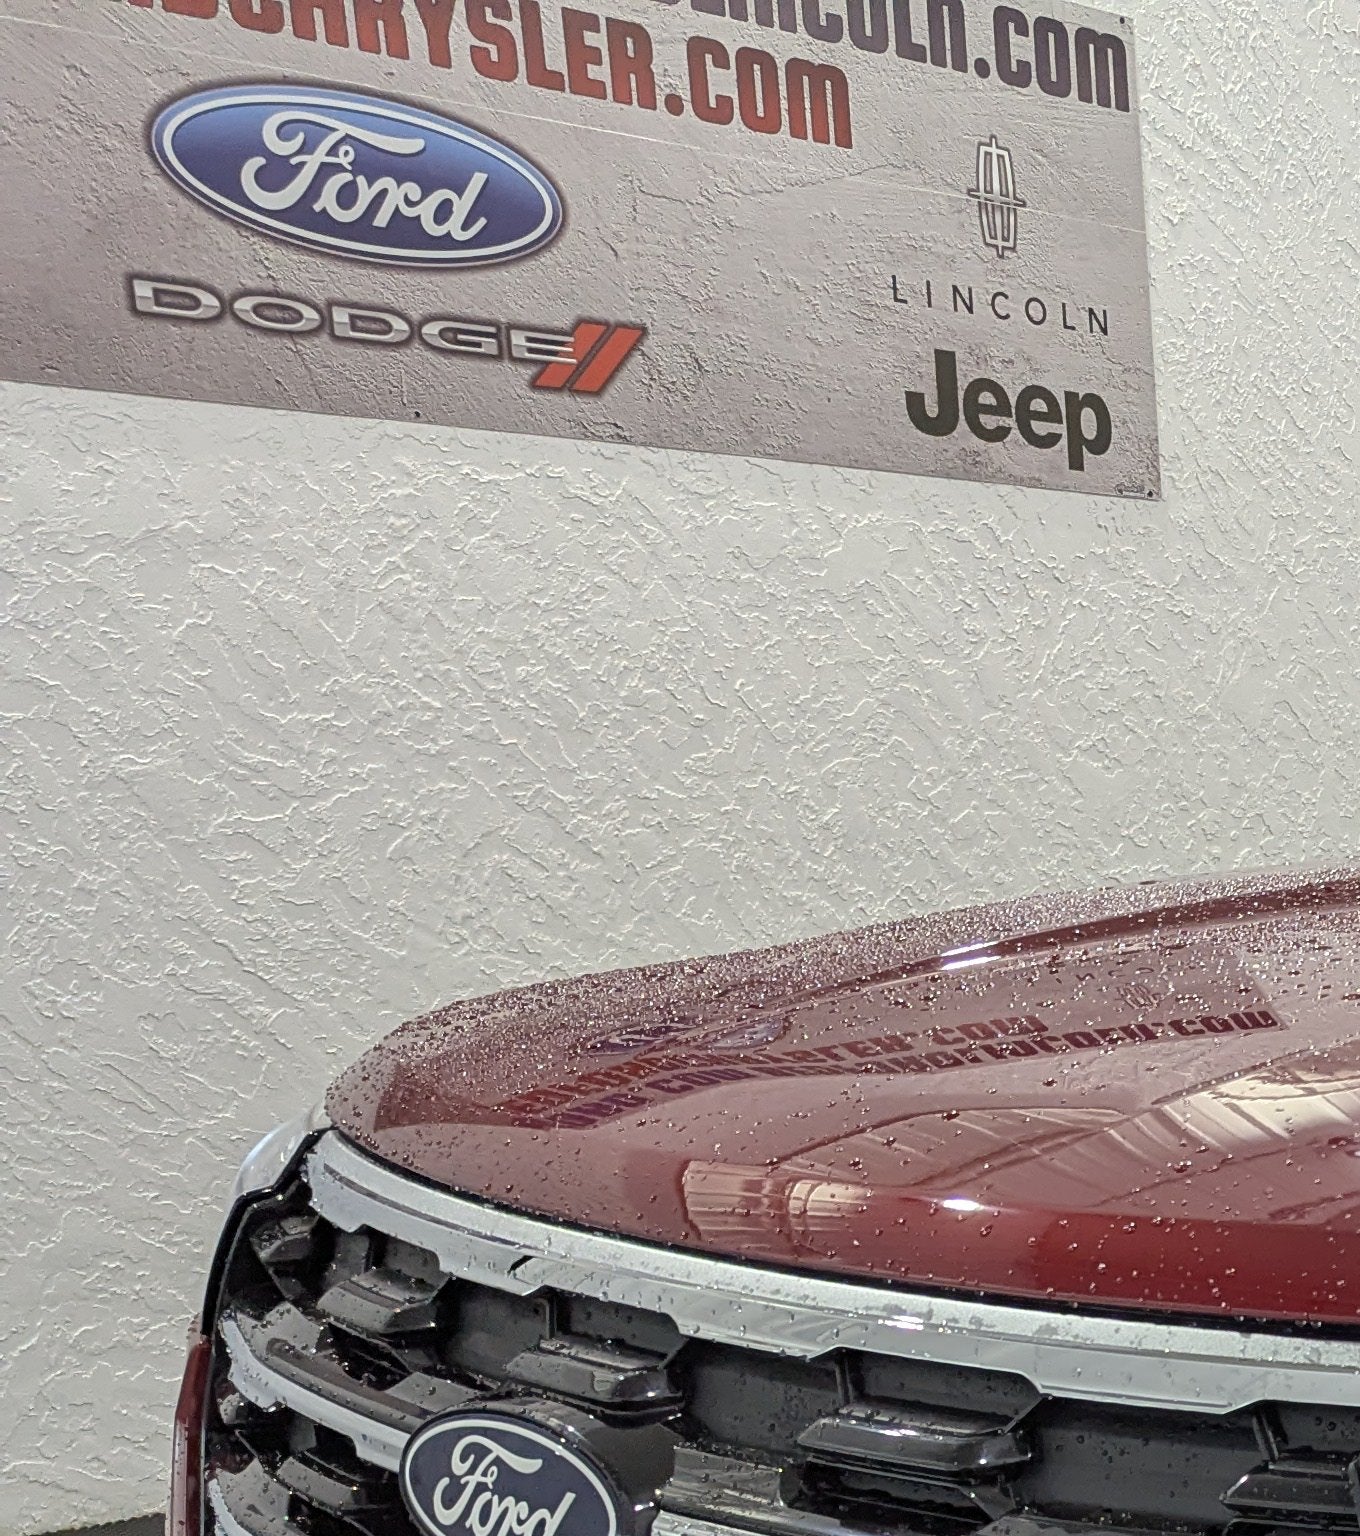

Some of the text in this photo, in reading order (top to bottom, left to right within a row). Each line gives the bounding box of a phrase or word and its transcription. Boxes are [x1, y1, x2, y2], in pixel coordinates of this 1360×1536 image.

[241, 110, 490, 242] Ford
[134, 280, 577, 364] DODGE
[890, 275, 1110, 337] LINCOLN
[905, 349, 1114, 470] Jeep
